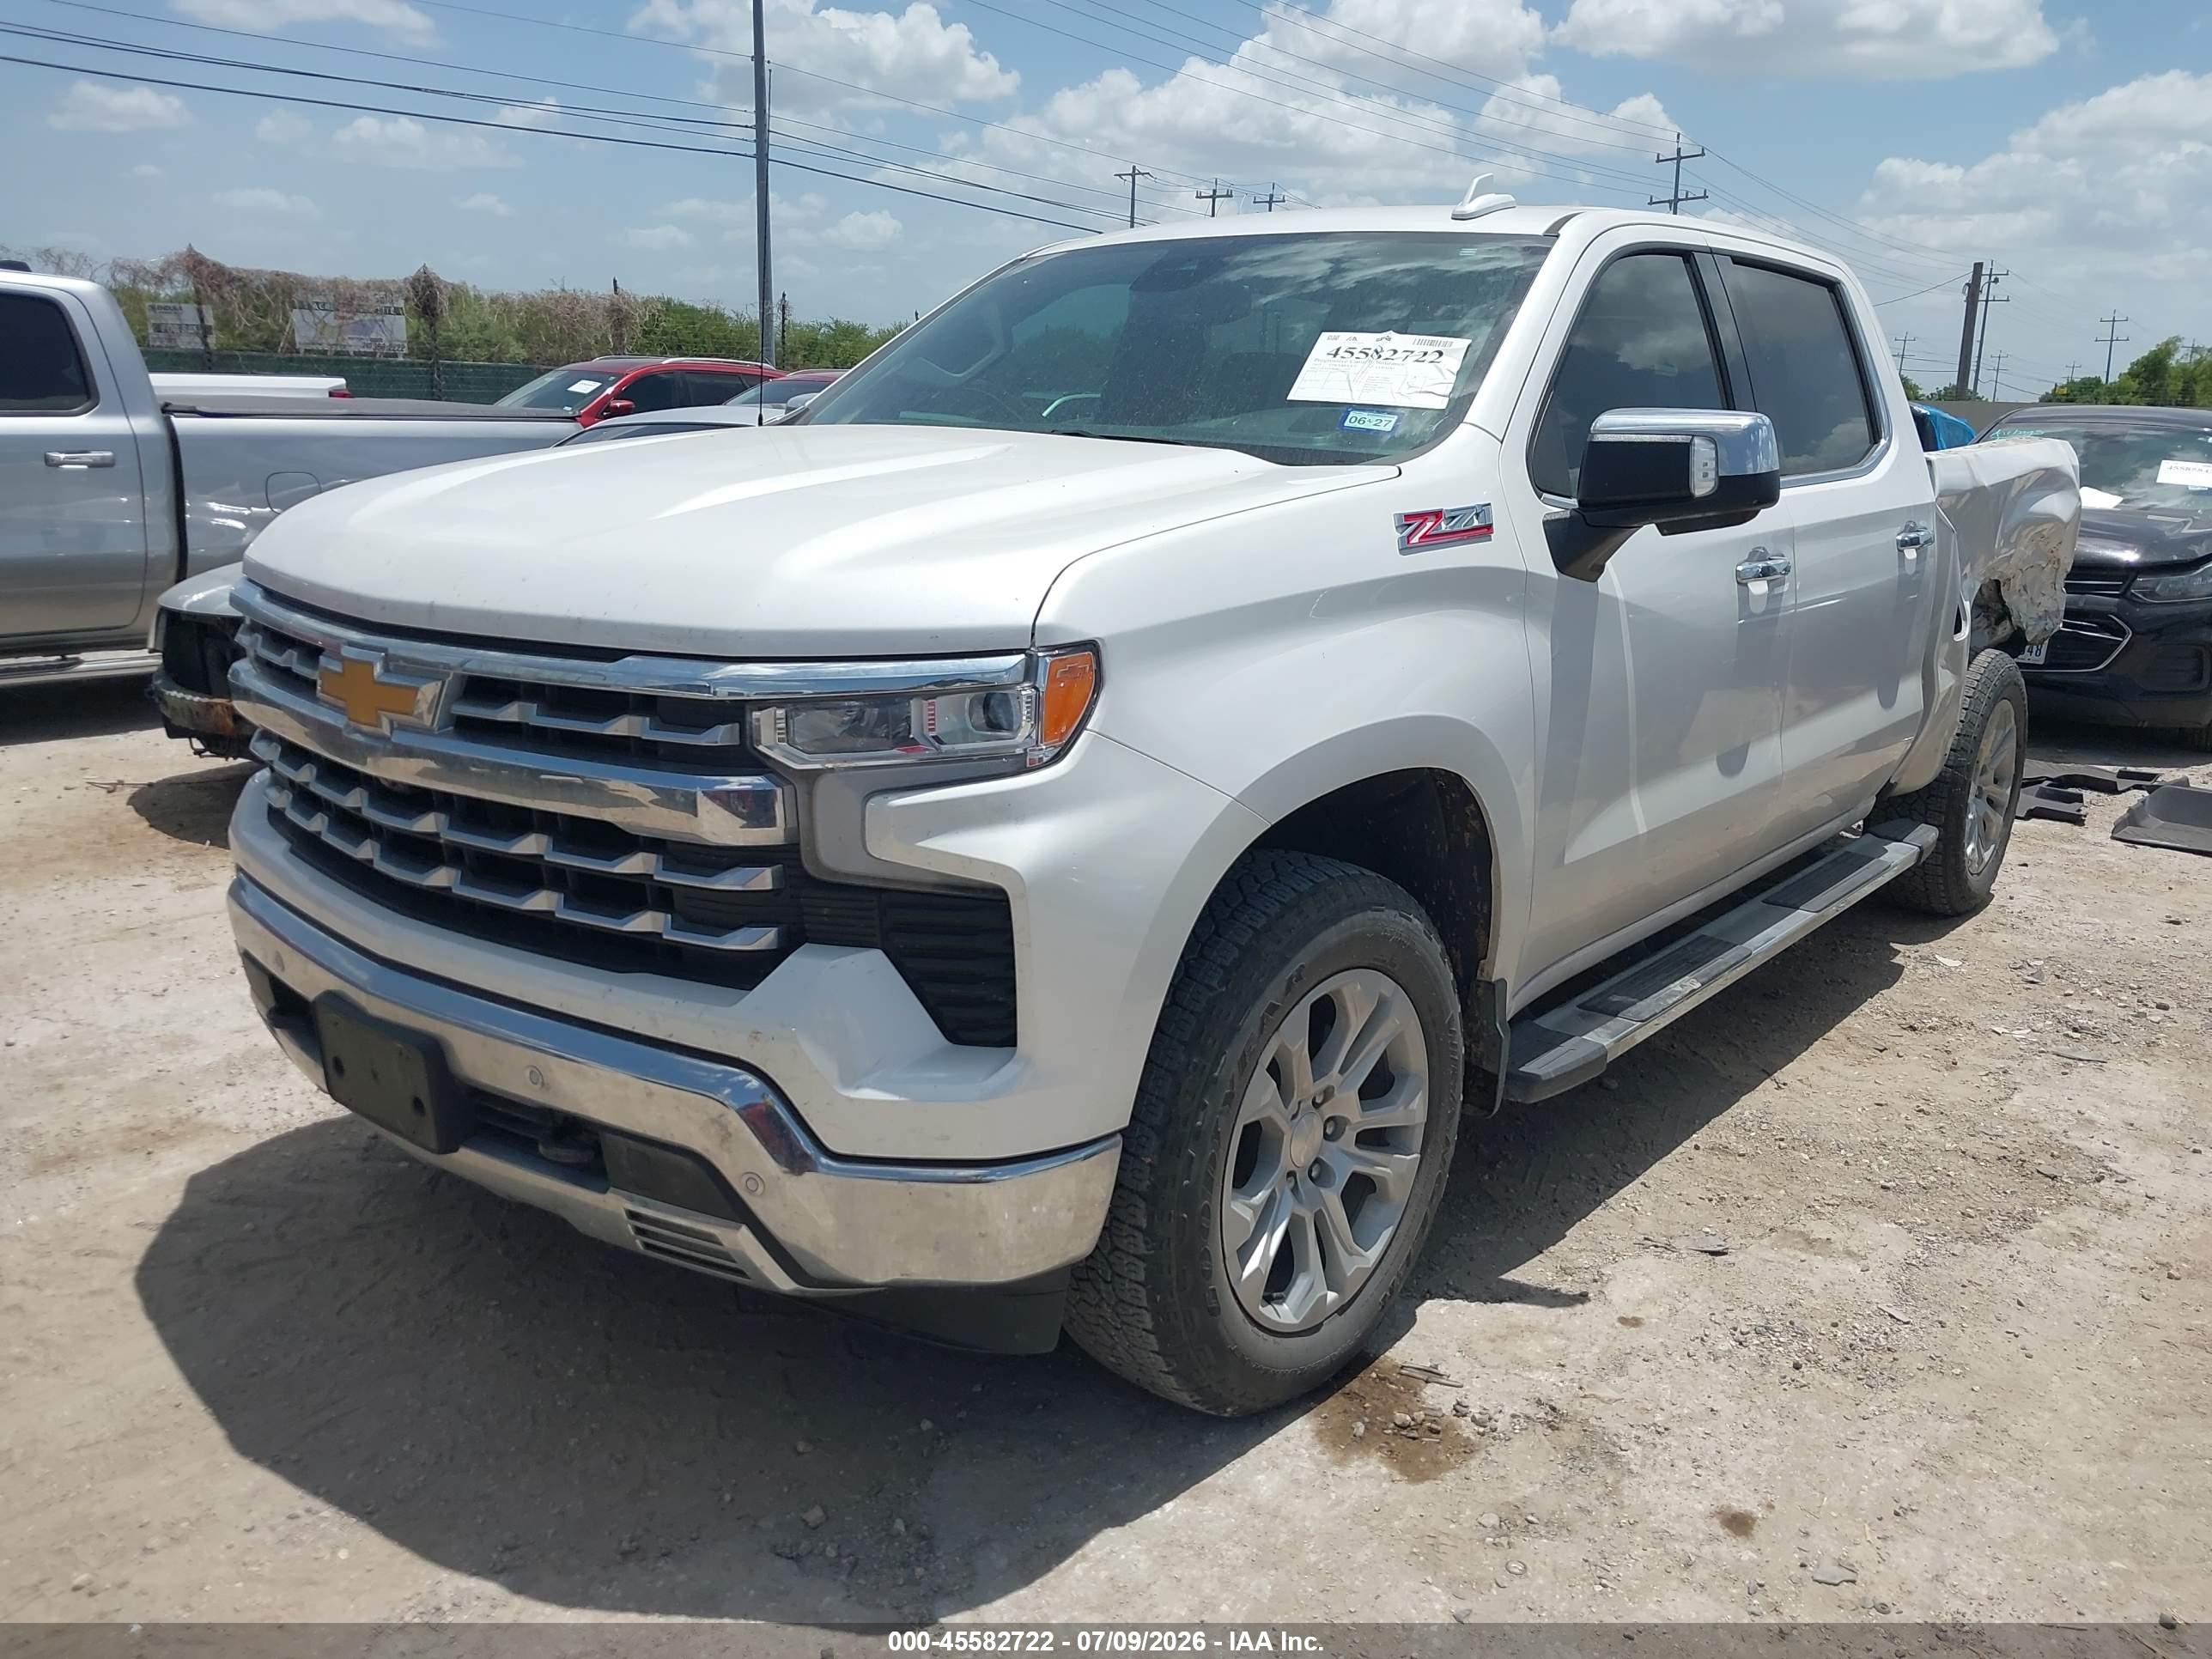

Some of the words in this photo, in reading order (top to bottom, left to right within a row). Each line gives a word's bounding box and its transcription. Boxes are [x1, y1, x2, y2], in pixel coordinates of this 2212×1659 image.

[1326, 344, 1444, 364] 45582722
[1348, 416, 1367, 425] 06
[1372, 418, 1393, 428] 27
[1396, 504, 1492, 550] Z71
